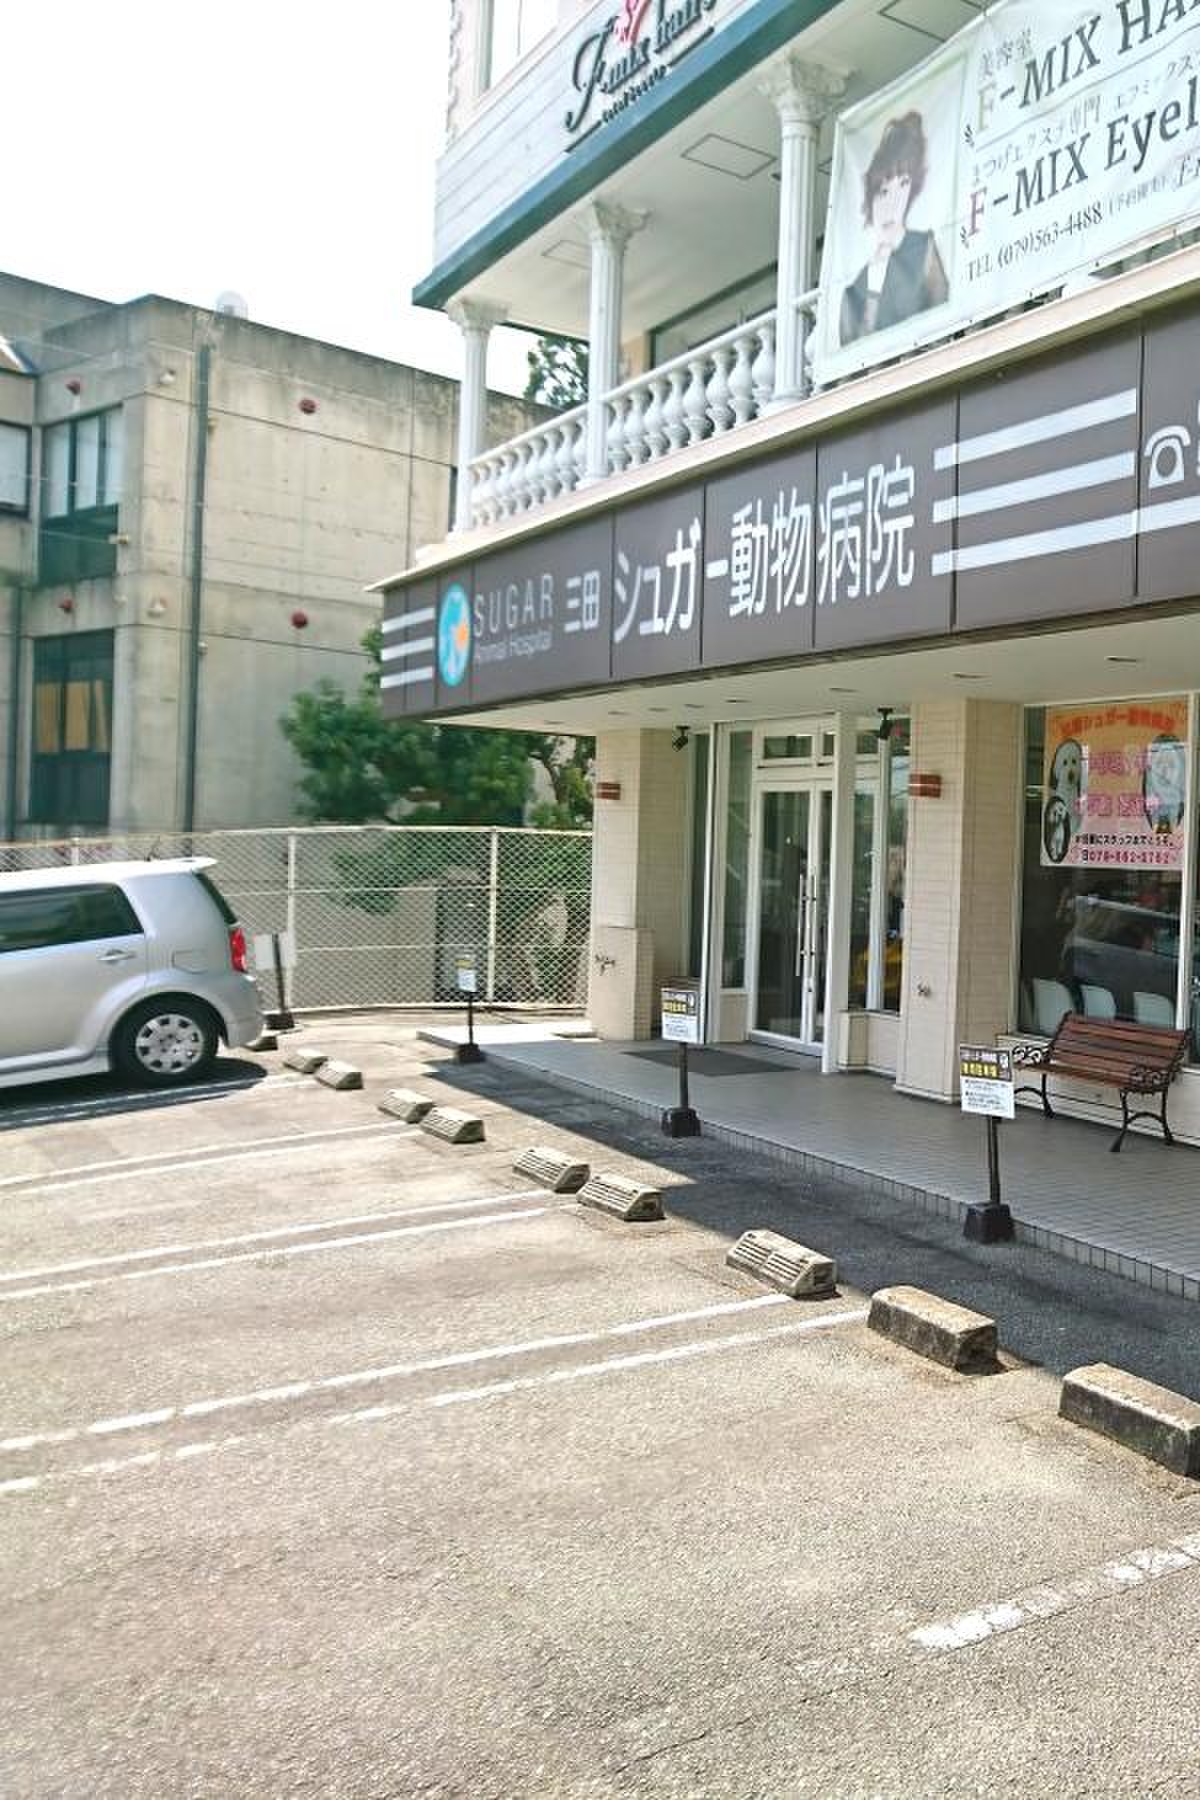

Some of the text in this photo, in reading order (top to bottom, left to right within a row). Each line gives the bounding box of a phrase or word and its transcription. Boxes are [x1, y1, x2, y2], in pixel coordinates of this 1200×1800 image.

[977, 0, 1200, 132] F-MIX HA
[966, 131, 1092, 236] F-MIX
[967, 255, 993, 283] TEL
[564, 453, 915, 643] 三田 シュガー動物病院
[473, 573, 554, 638] SUGAR
